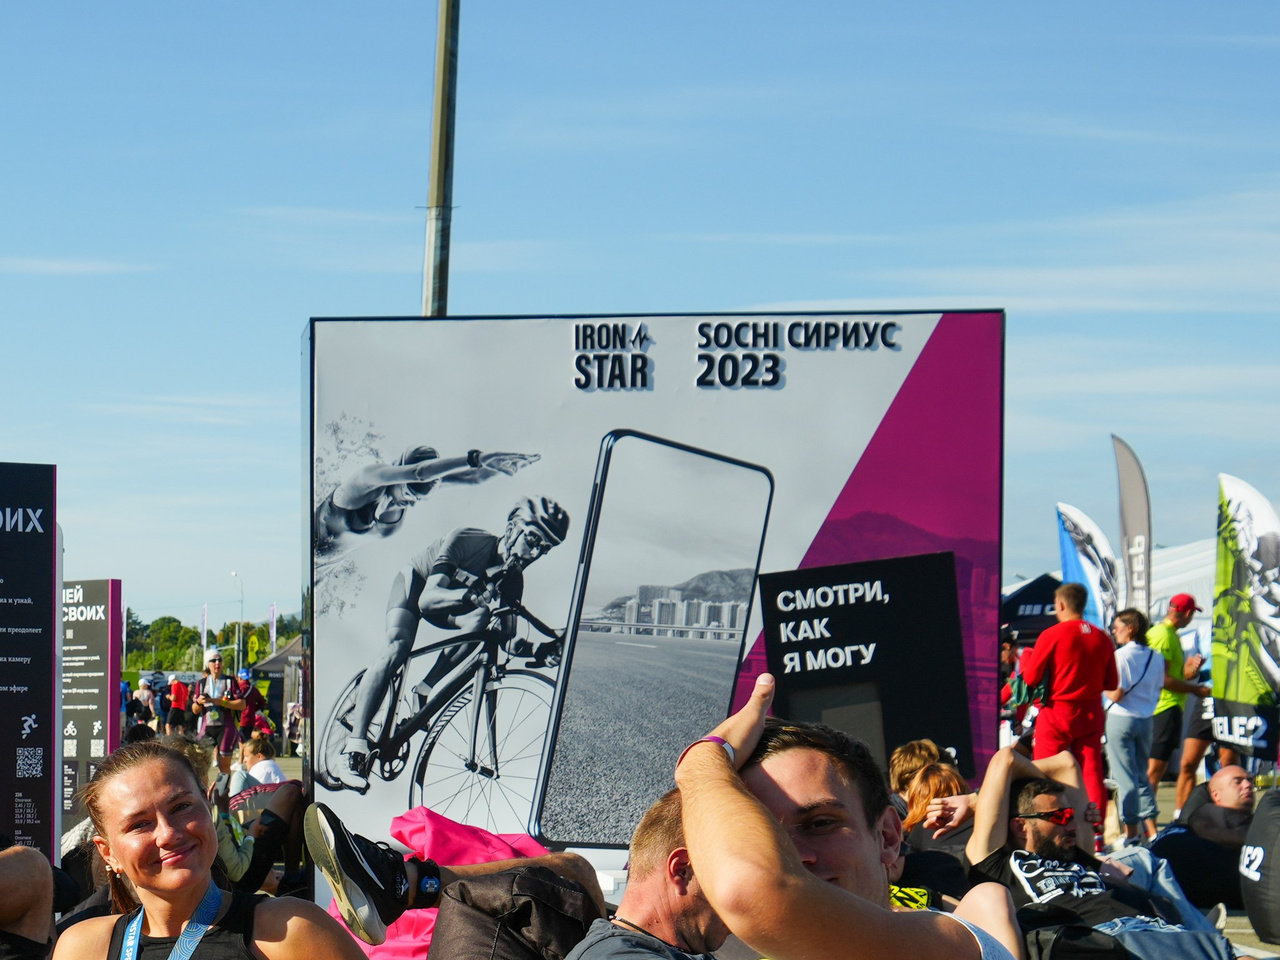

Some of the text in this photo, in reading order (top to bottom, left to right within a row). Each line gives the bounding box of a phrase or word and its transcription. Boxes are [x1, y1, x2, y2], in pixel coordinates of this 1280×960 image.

[574, 323, 627, 350] IRON
[697, 322, 897, 348] SOCHI СИРИУС
[574, 353, 648, 388] STAR
[696, 353, 781, 387] 2023
[14, 597, 33, 605] узнай,
[777, 580, 889, 612] СМОТРИ,
[780, 617, 831, 643] КАК
[783, 642, 877, 674] Я МОГУ
[9, 685, 28, 693] эфире
